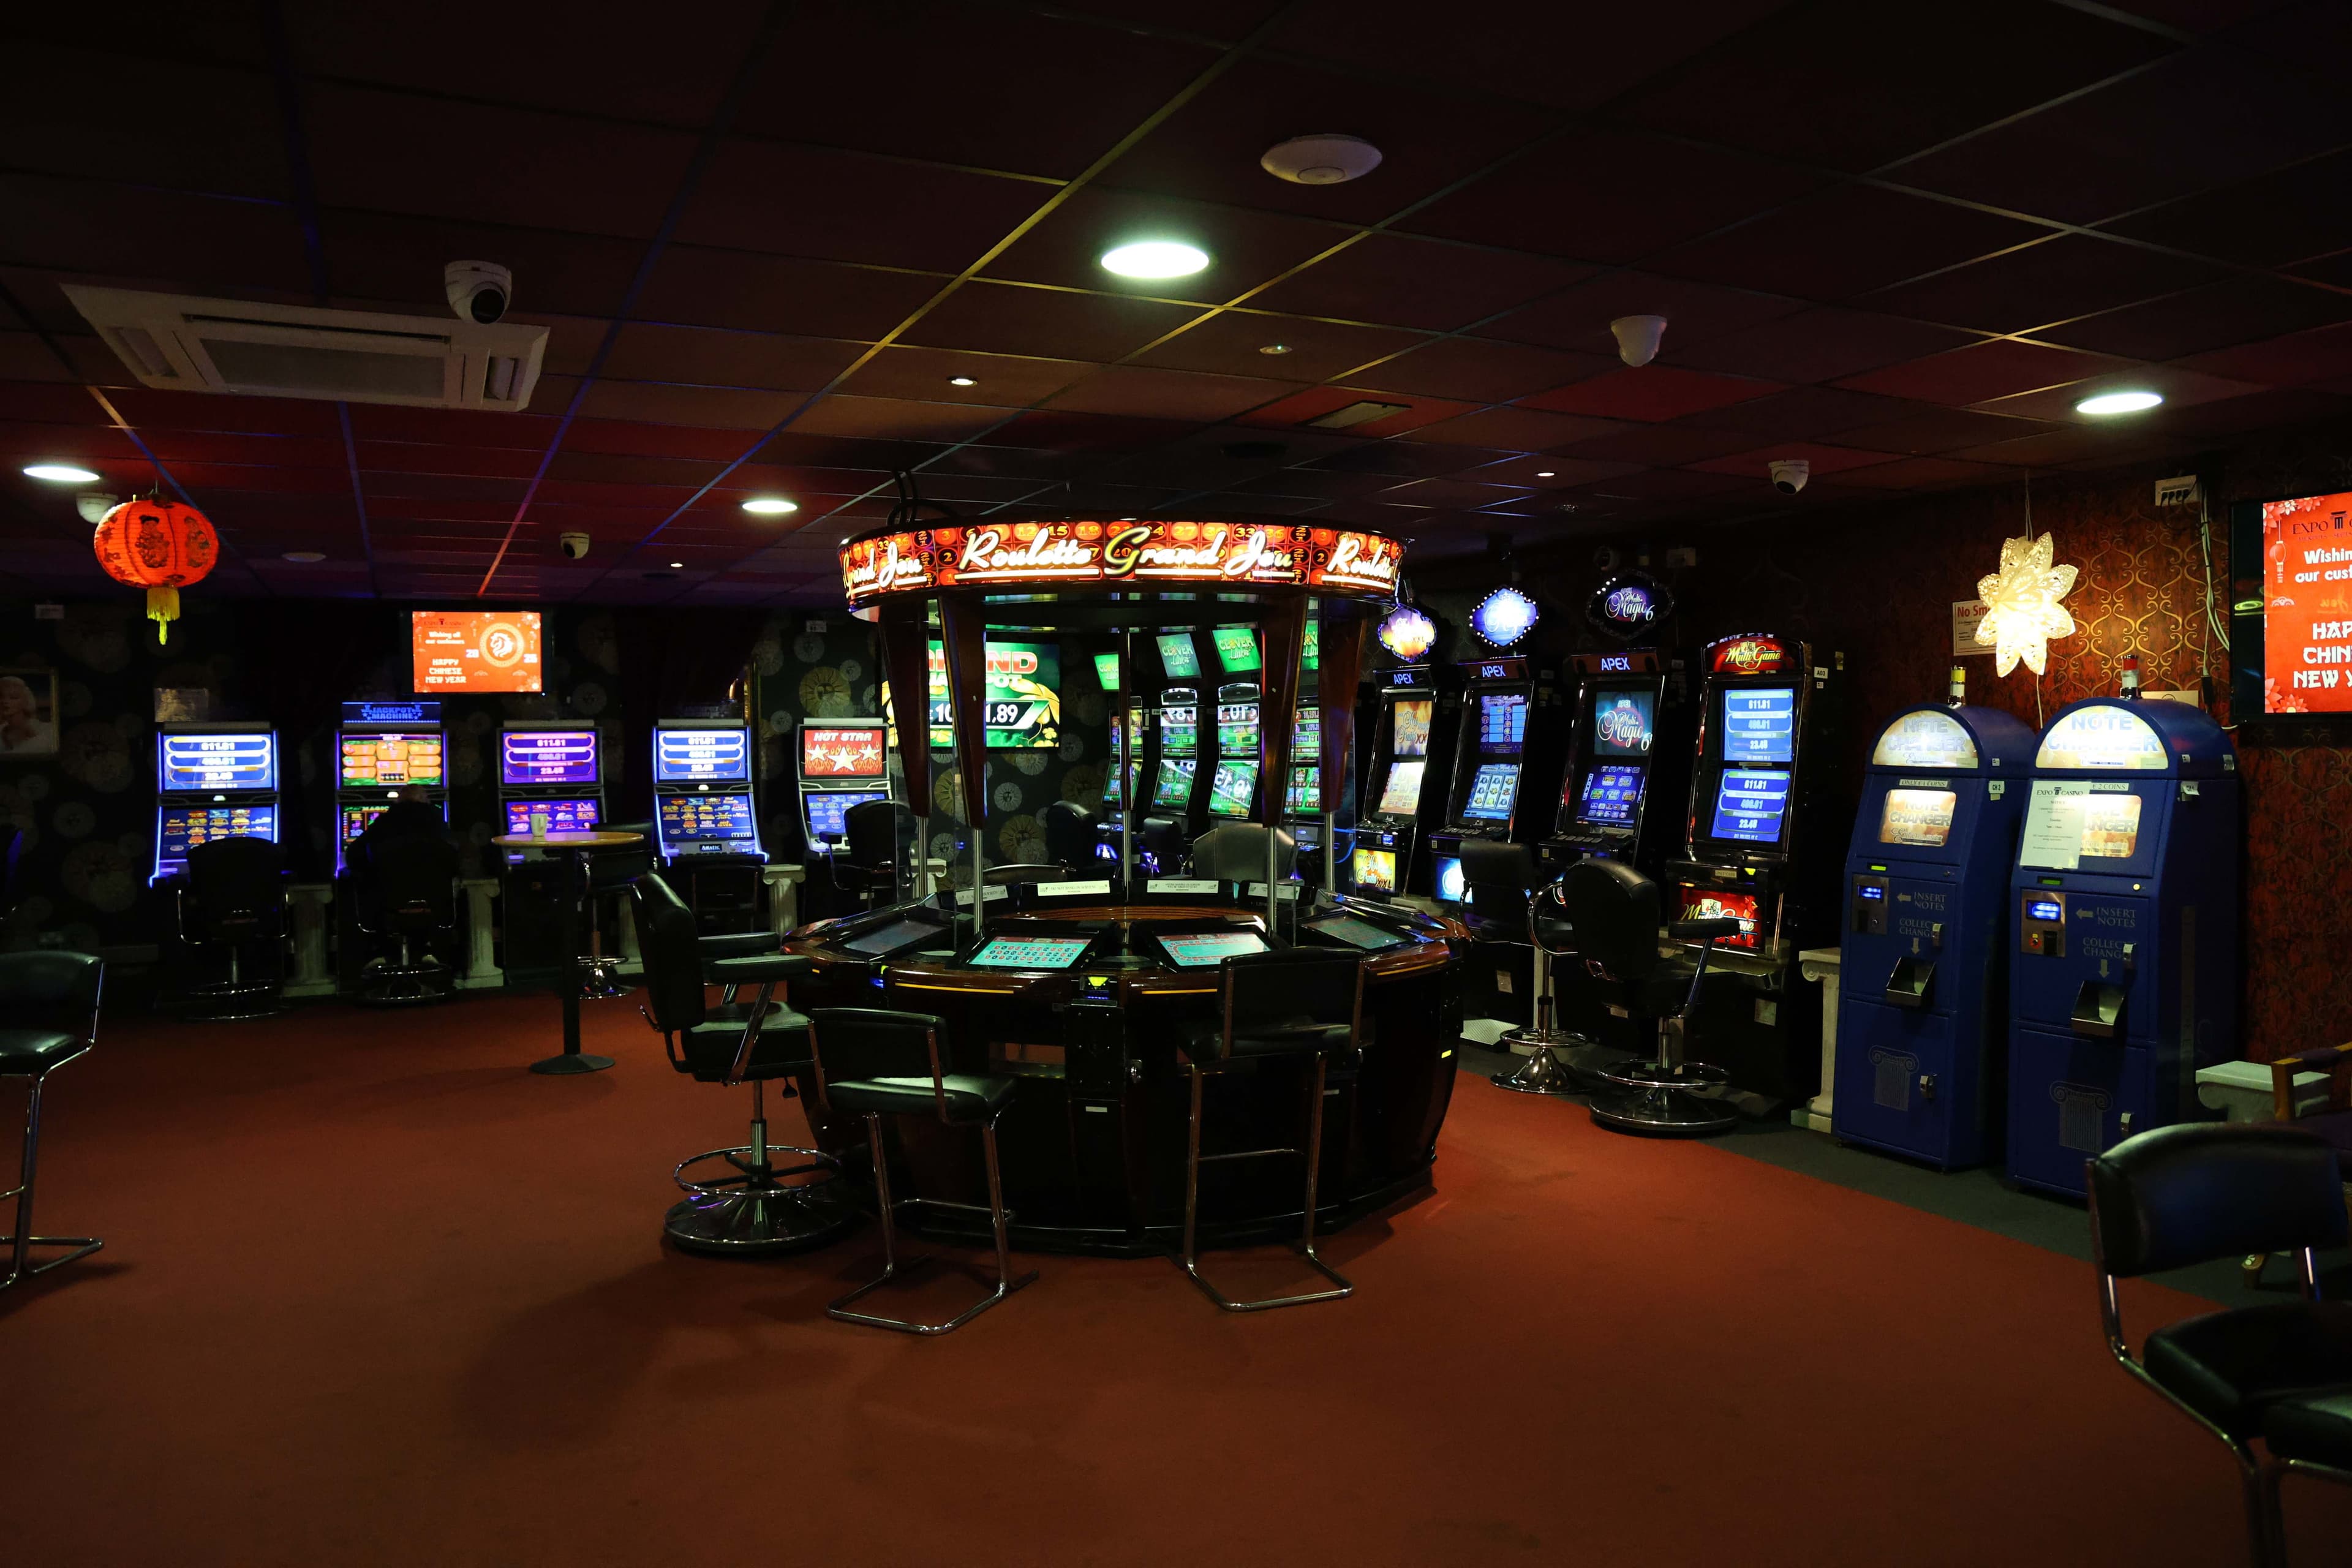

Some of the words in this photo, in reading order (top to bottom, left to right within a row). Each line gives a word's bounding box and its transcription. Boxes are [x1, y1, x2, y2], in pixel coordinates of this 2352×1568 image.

[1048, 526, 1068, 535] 15
[1078, 526, 1099, 535] 18
[1172, 526, 1191, 535] 27
[2293, 521, 2328, 534] EXPO
[941, 531, 950, 540] 3
[1267, 529, 1284, 538] 36
[1321, 532, 1327, 541] 3
[959, 527, 1092, 570] Roulette
[1104, 526, 1226, 575] Grand
[1224, 529, 1293, 576] Jeu
[2304, 548, 2352, 564] Wishin
[944, 552, 952, 562] 2
[1317, 553, 1325, 562] 2
[1327, 538, 1392, 579] Roulette
[2294, 571, 2320, 583] our
[1605, 592, 1647, 622] Magic
[1958, 606, 1970, 617] No
[2312, 620, 2352, 639] HAP
[1751, 646, 1781, 670] Game
[2303, 645, 2352, 665] CHIN
[1601, 658, 1630, 671] APEX
[1482, 664, 1506, 677] APEX
[1393, 674, 1414, 685] APEX
[2293, 669, 2339, 689] NEW
[1904, 718, 1948, 733] NOTE
[2071, 714, 2133, 731] NOTE
[1597, 710, 1644, 748] Magic
[813, 733, 839, 742] HOT
[840, 733, 873, 742] STAR
[1415, 733, 1428, 744] XX
[1890, 812, 1951, 826] CHANGER
[1914, 892, 1945, 902] INSERT
[1915, 901, 1945, 911] NOTES
[2097, 907, 2136, 918] INSERT
[2097, 918, 2136, 927] NOTES
[1899, 927, 1932, 938] CHANG
[2083, 948, 2124, 959] CHANG
